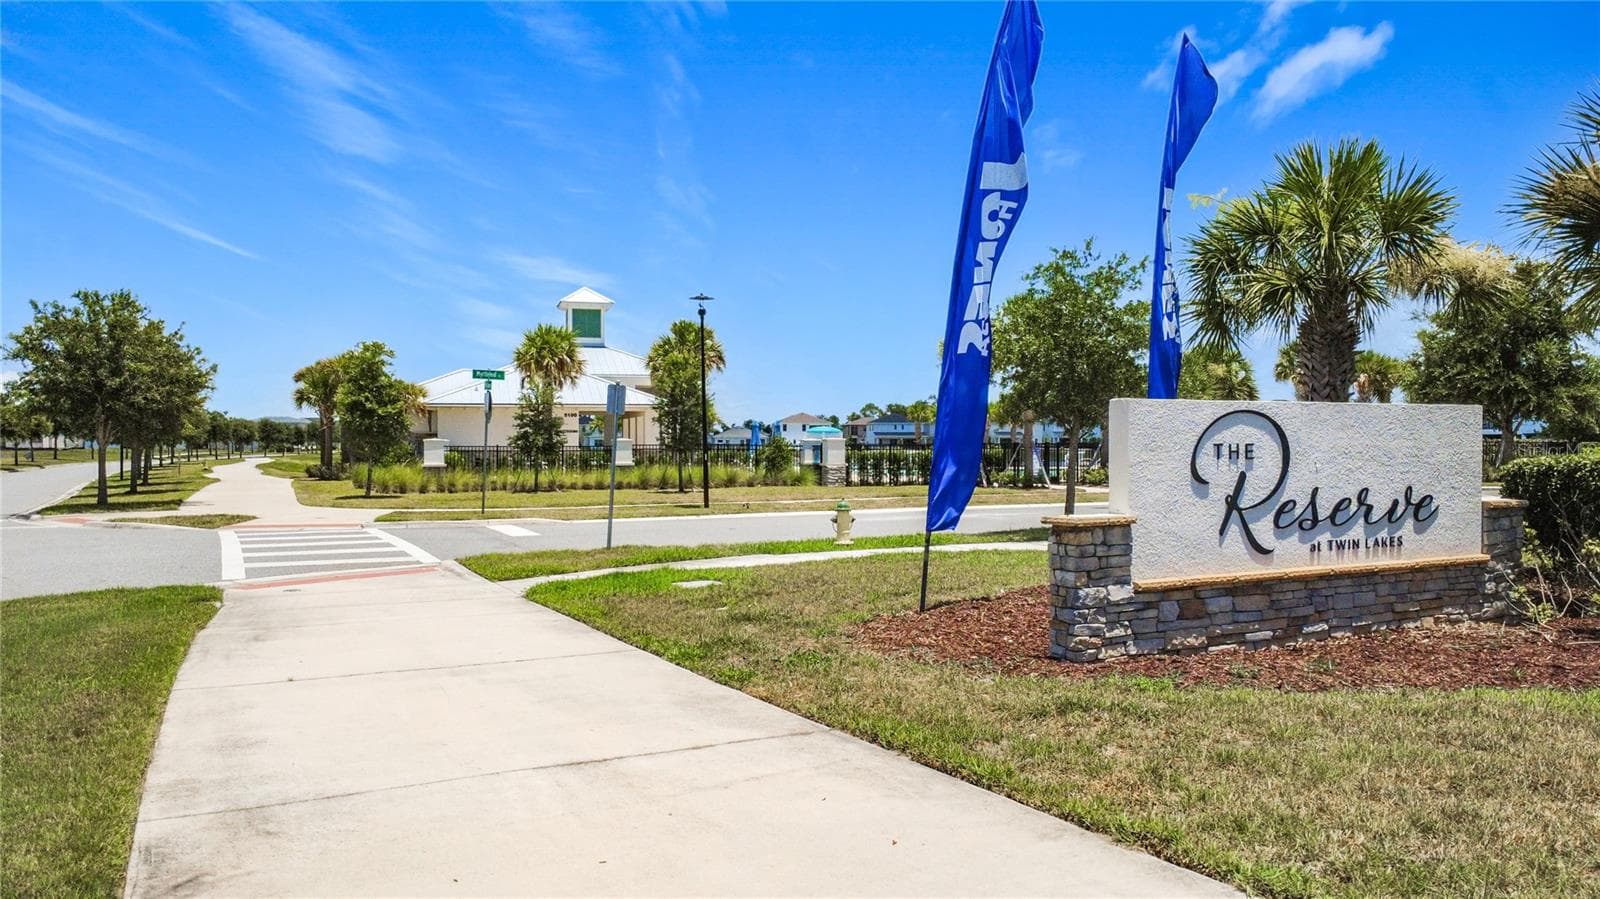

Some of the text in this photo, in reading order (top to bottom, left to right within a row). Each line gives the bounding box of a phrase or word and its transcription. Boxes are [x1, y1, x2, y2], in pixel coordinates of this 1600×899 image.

[1213, 443, 1255, 460] THE
[1190, 409, 1440, 555] Reserve
[1309, 536, 1403, 552] at TWIN LAKES
